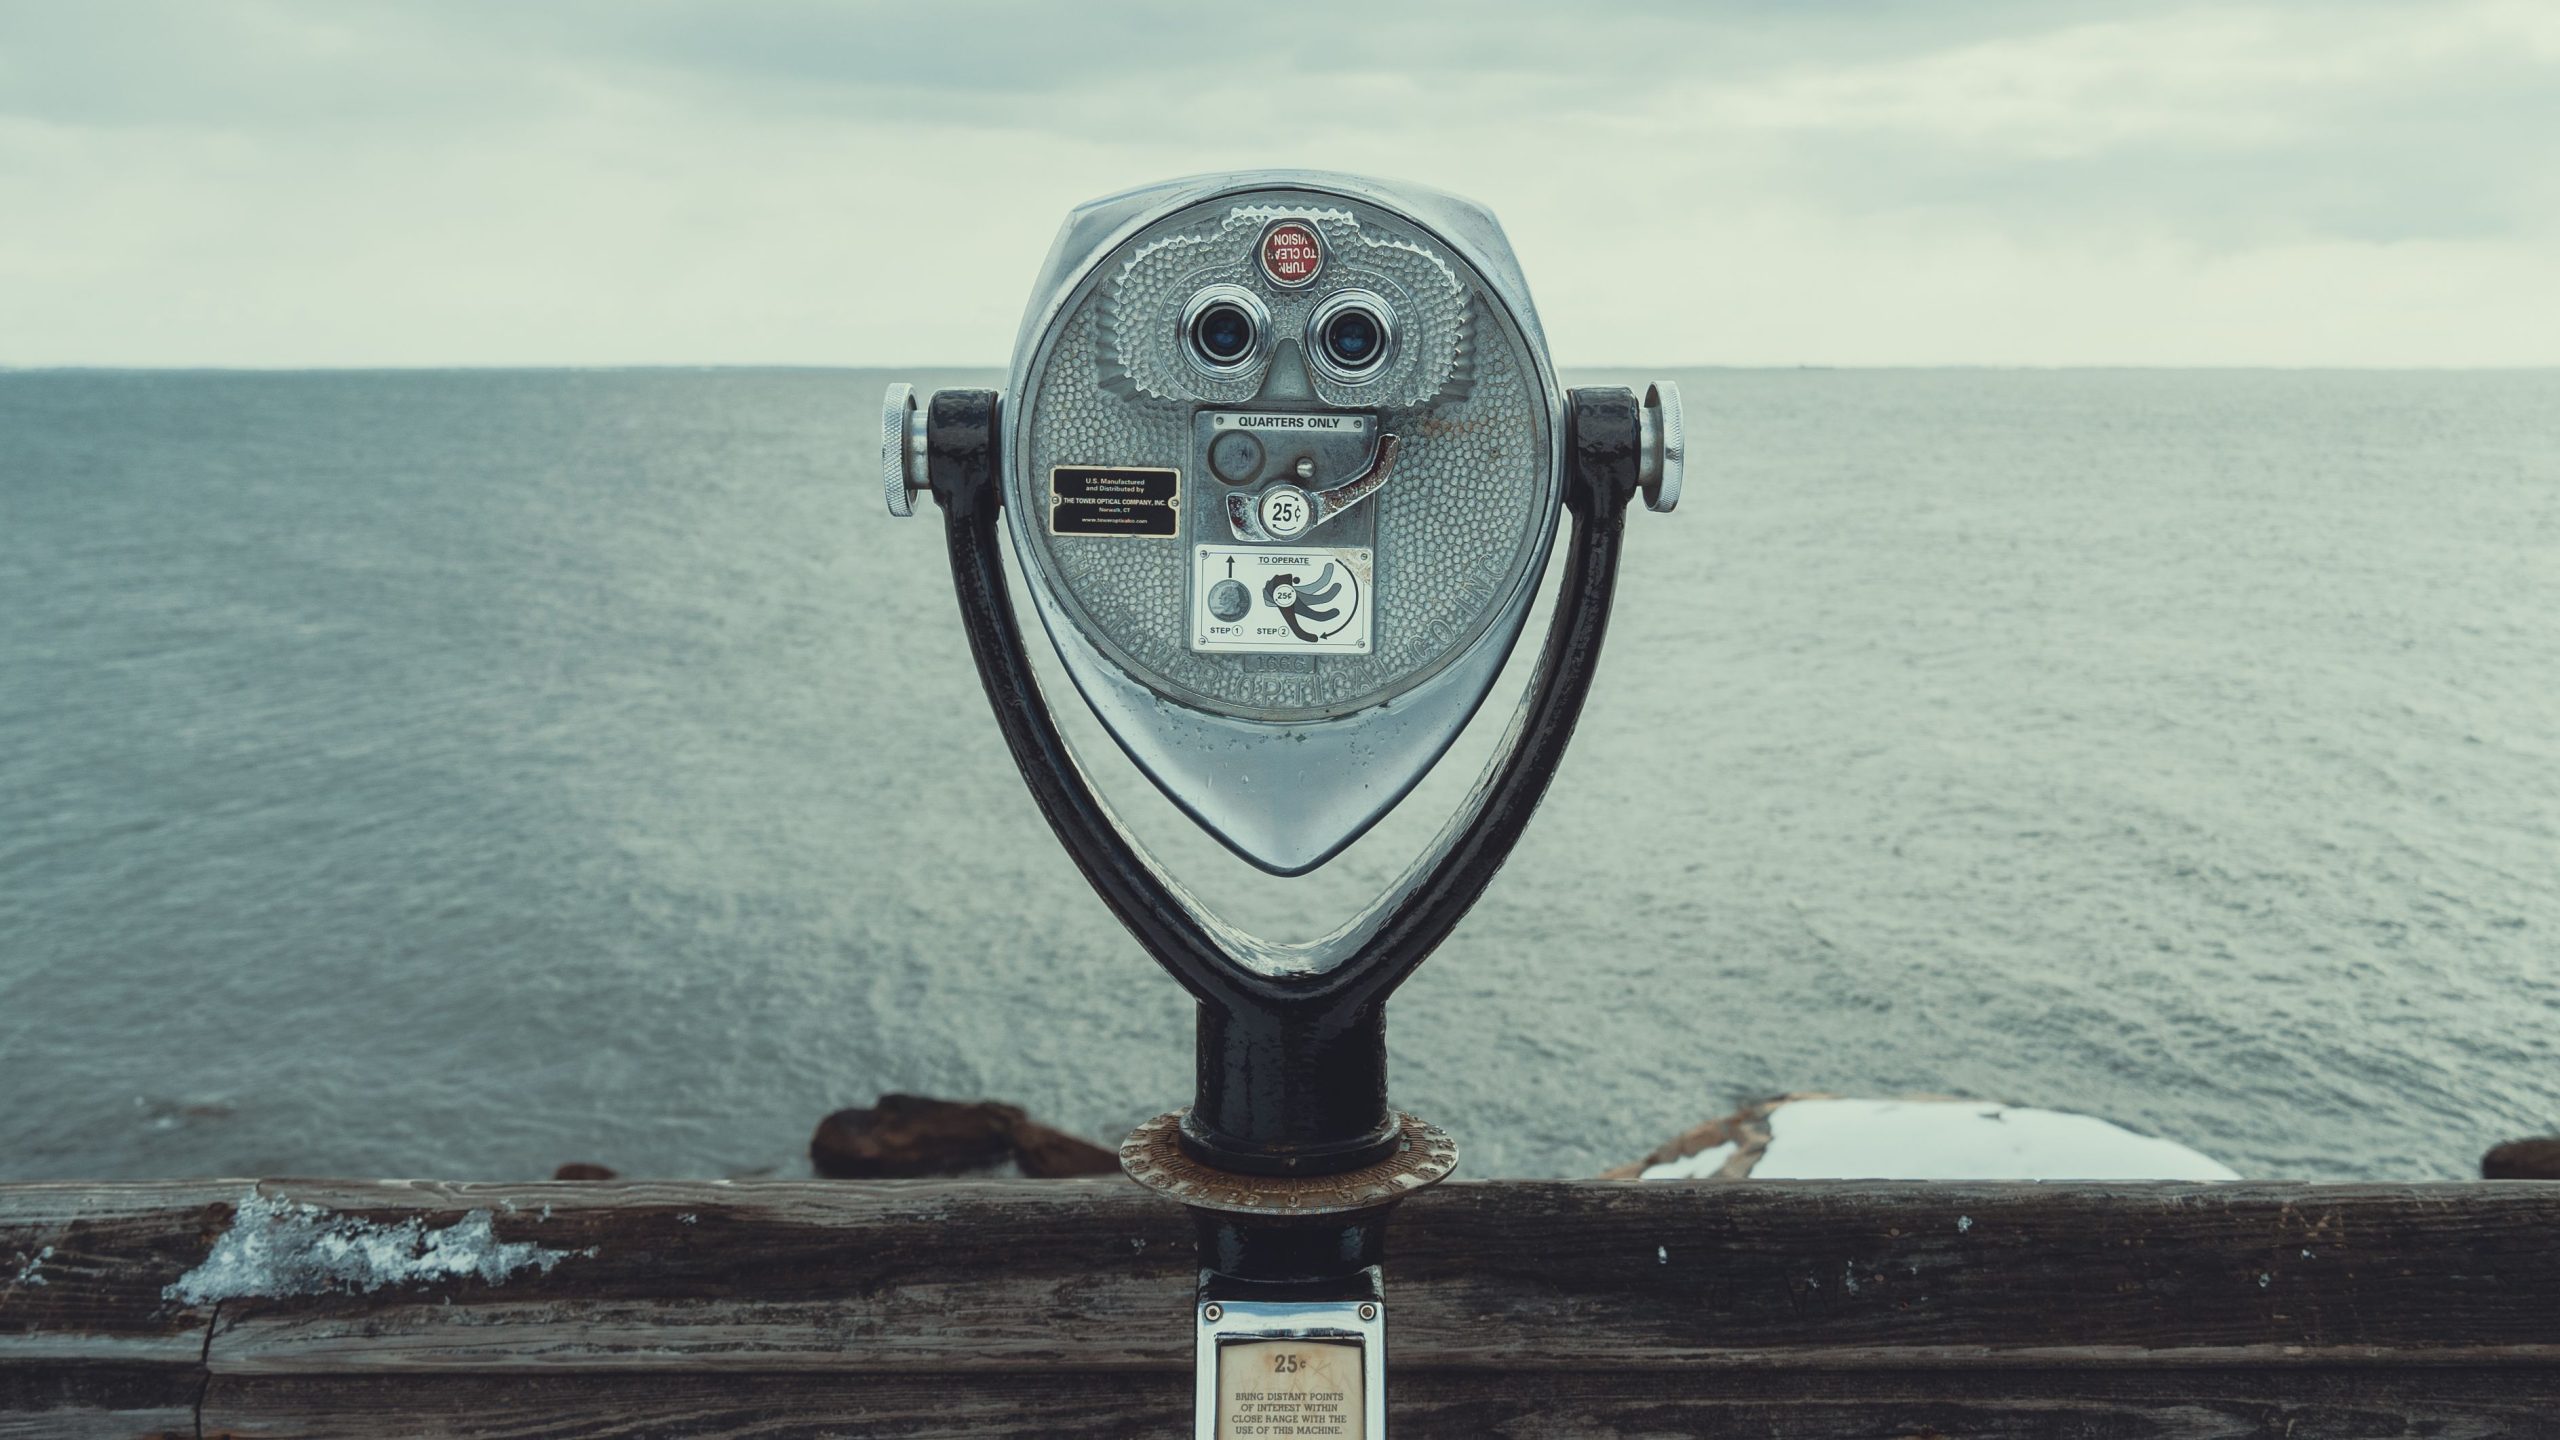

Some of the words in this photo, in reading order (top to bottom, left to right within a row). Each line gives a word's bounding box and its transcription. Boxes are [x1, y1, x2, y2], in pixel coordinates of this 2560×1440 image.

[1273, 233, 1308, 246] VISION
[1302, 247, 1317, 259] TO
[1238, 416, 1304, 428] QUARTERS
[1307, 417, 1340, 429] ONLY
[1258, 556, 1270, 564] TO
[1271, 556, 1310, 564] OPERATE
[1277, 591, 1292, 600] 25¢
[1210, 626, 1231, 634] STEP
[1256, 627, 1277, 635] STEP
[1235, 1392, 1264, 1401] BRING
[1267, 1392, 1307, 1401] DISTANT
[1310, 1392, 1344, 1401] POINTS
[1240, 1403, 1254, 1412] OF
[1257, 1403, 1302, 1412] INTEREST
[1304, 1403, 1338, 1412] WITHIN
[1231, 1414, 1263, 1424] CLOSE
[1265, 1414, 1298, 1423] RANGE
[1301, 1414, 1326, 1423] WITH
[1328, 1414, 1347, 1424] THE
[1235, 1426, 1254, 1435] USE
[1256, 1425, 1270, 1435] OF
[1273, 1425, 1294, 1435] THIS
[1296, 1425, 1343, 1435] MACHINE.
